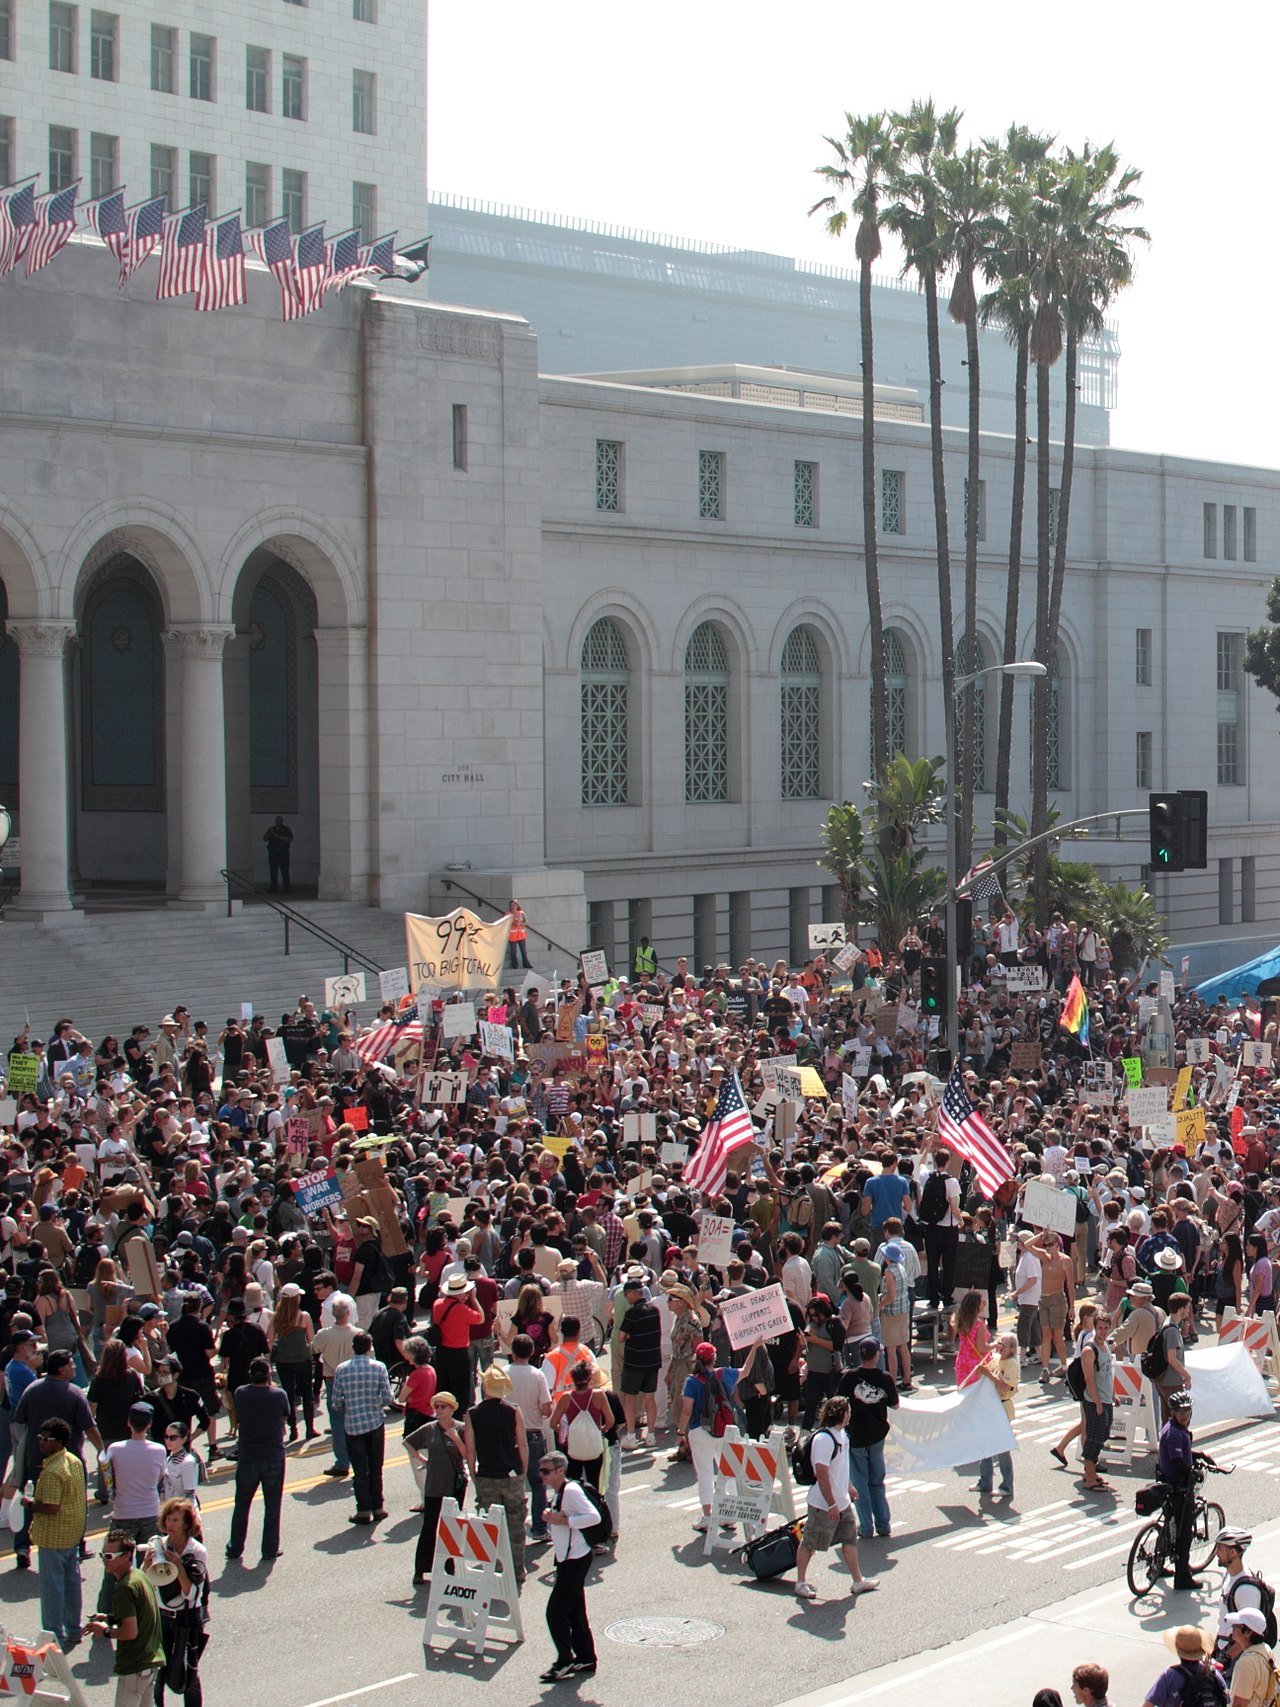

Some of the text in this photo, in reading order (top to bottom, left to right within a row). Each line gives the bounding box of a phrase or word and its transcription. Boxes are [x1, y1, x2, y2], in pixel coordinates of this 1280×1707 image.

[442, 773, 484, 782] CITY HALL
[413, 961, 436, 980] TOO
[439, 958, 460, 977] BIG
[776, 1067, 788, 1081] We
[777, 1082, 790, 1097] the
[298, 1169, 328, 1189] STOP
[306, 1180, 330, 1197] WAR
[302, 1191, 342, 1213] WORKERS
[750, 1290, 781, 1306] DEADLOCK
[741, 1306, 772, 1323] SUPPORTS
[731, 1315, 788, 1342] CORPORATE GREED
[719, 1509, 761, 1521] STREET SERVICES
[443, 1584, 477, 1600] LADOT
